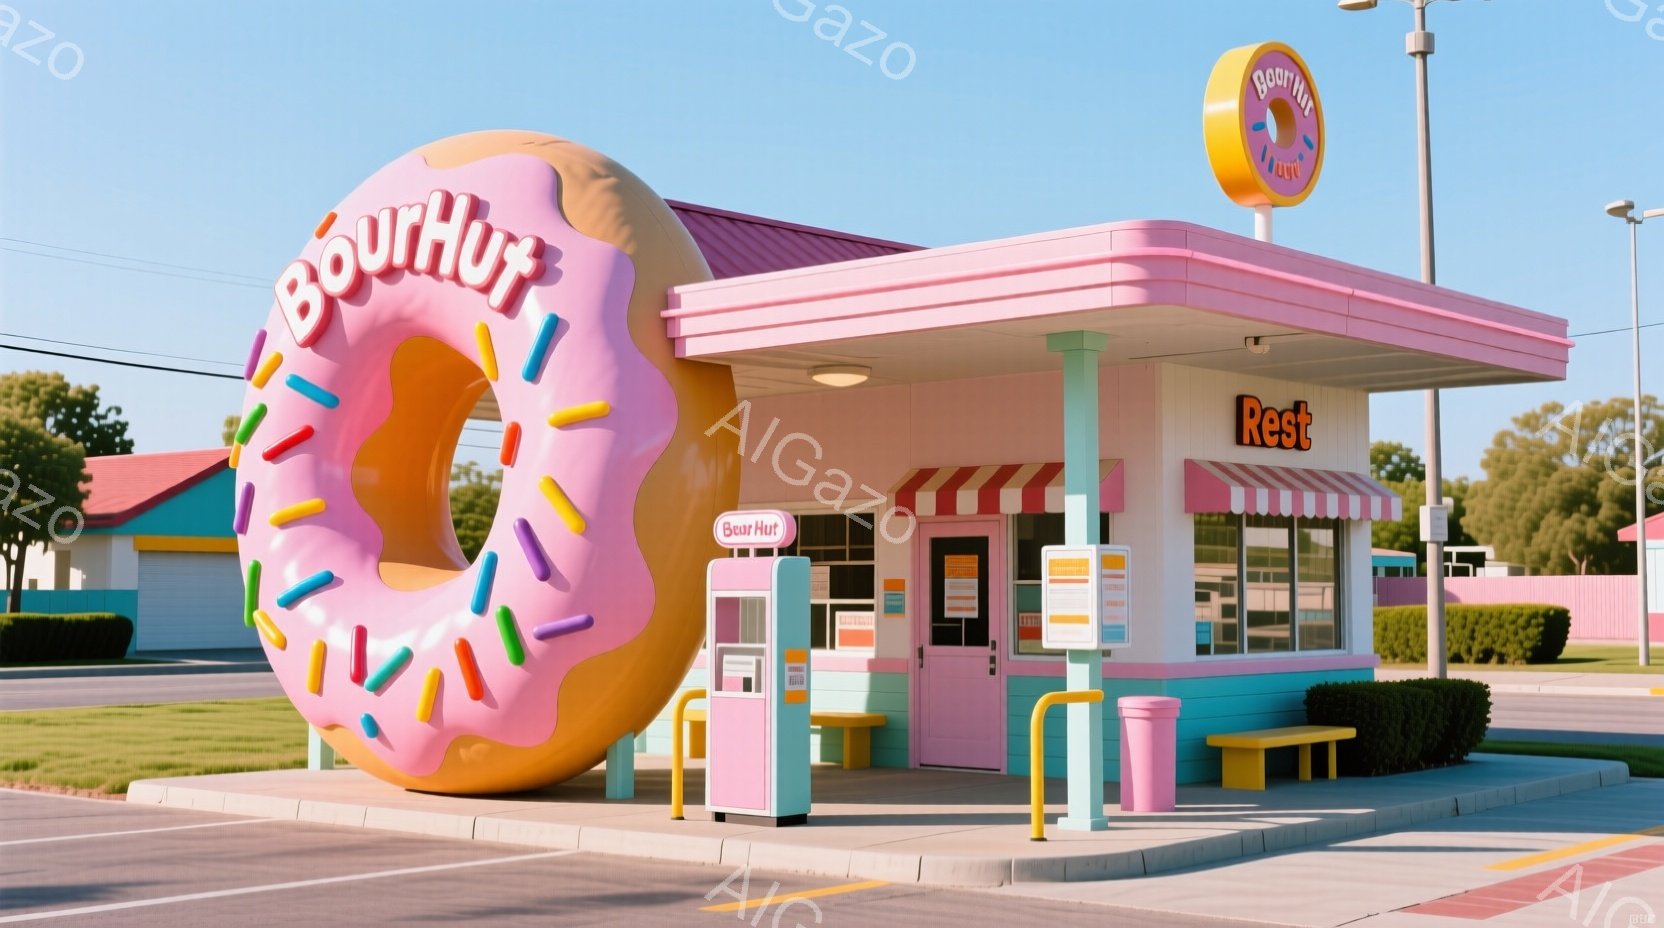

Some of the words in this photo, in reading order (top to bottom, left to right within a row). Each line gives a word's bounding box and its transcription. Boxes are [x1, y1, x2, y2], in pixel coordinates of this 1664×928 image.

[274, 189, 545, 347] BourHut
[1236, 394, 1312, 451] Rest
[755, 519, 779, 537] Hut
